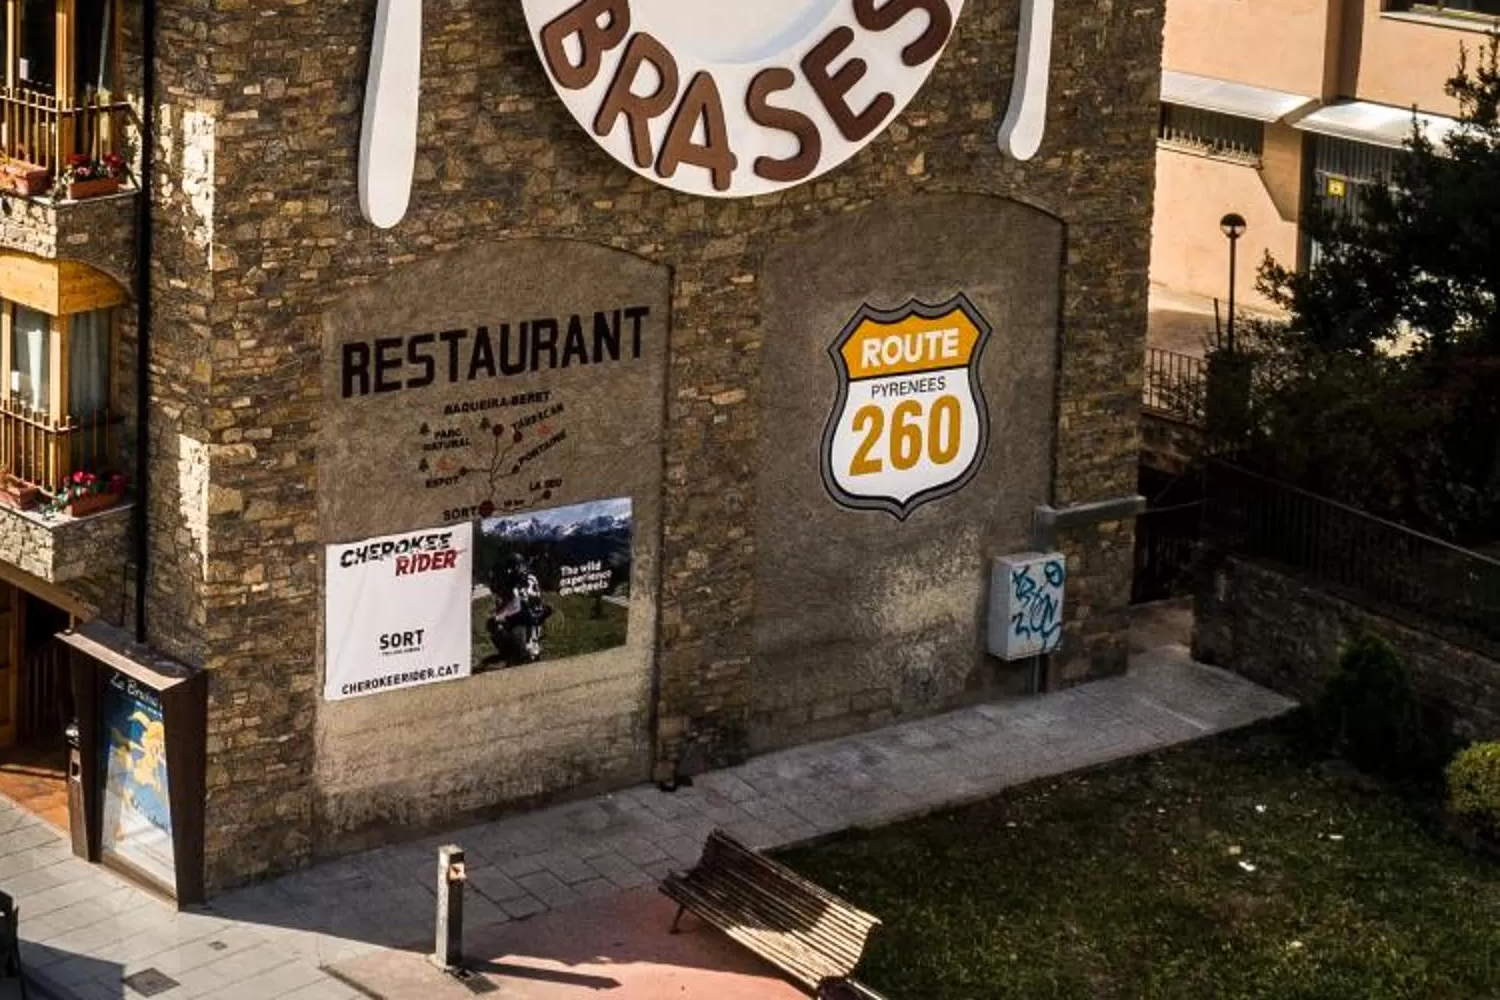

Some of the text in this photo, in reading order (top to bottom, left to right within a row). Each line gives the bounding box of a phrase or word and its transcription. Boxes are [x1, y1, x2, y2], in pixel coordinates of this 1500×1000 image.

[341, 306, 650, 399] RESTAURANT
[861, 328, 960, 369] ROUTE
[871, 376, 947, 399] PYRENEES
[849, 394, 962, 477] 260
[340, 532, 453, 568] CHEROKEE
[395, 549, 459, 577] RIDER
[379, 629, 425, 650] SORT
[341, 663, 461, 695] CHEROKEERIDER.CAT
